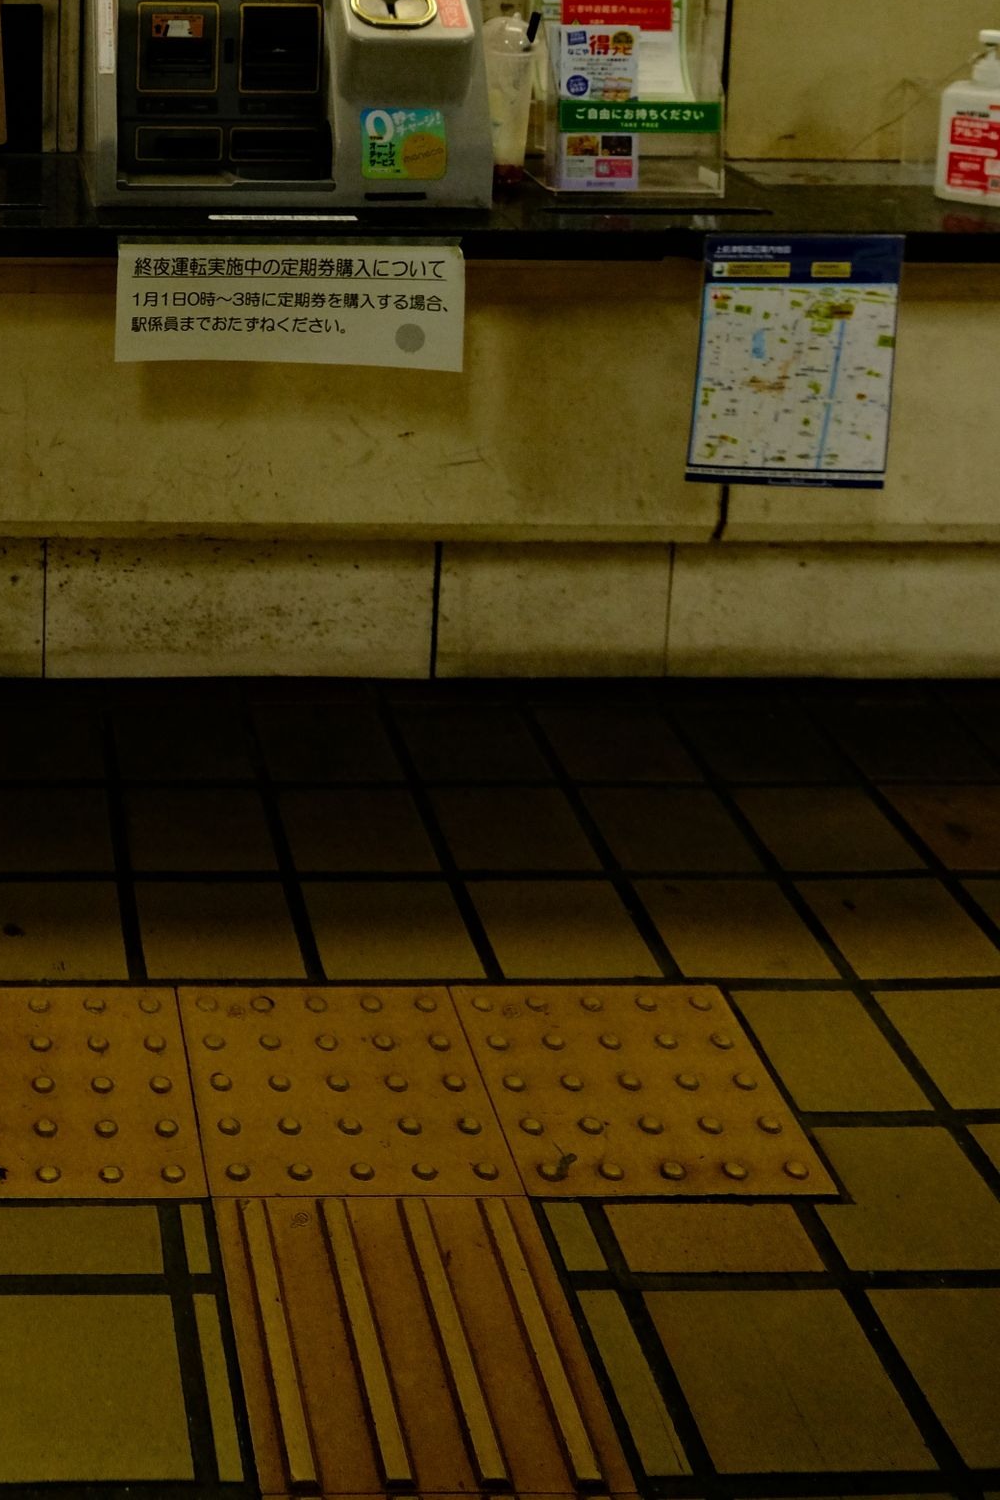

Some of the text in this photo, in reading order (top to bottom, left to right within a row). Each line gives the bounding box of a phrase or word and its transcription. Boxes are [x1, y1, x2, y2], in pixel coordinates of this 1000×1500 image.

[590, 35, 610, 55] 得
[576, 108, 704, 120] ご自由にお持ちください
[134, 258, 446, 278] 終夜運転実施中の定期券購入について
[131, 317, 346, 334] 駅係員までおたずねください。
